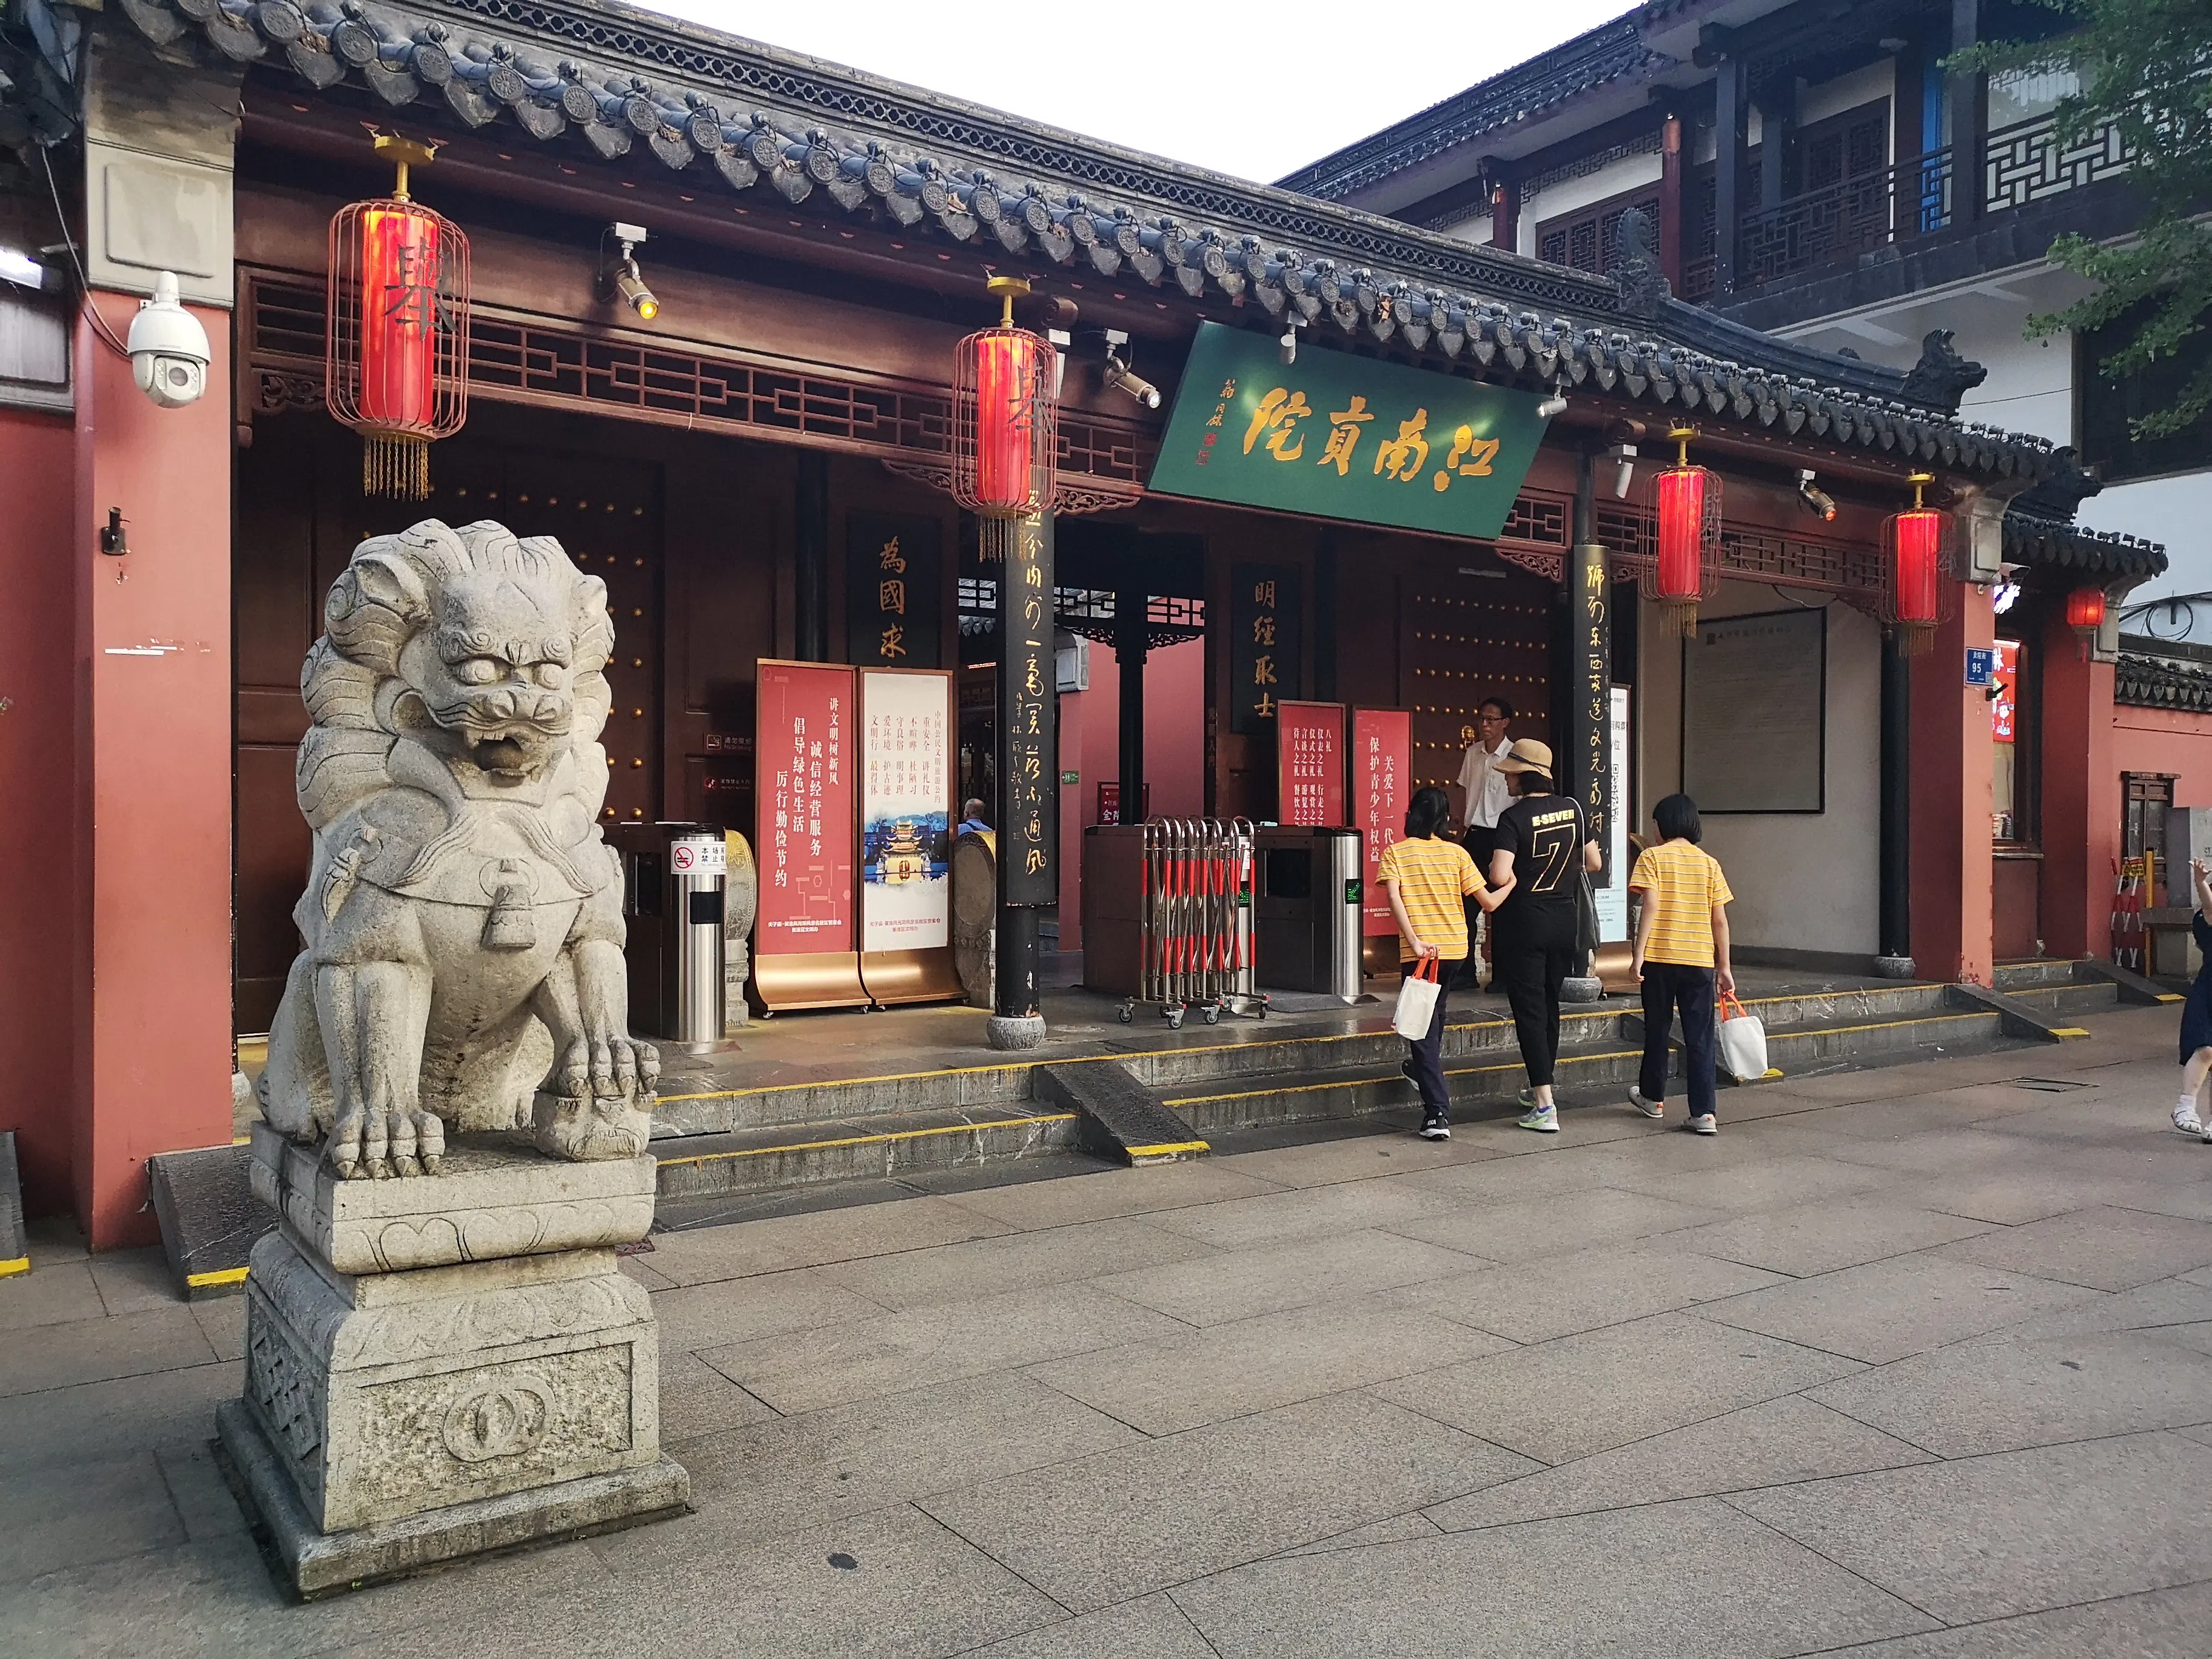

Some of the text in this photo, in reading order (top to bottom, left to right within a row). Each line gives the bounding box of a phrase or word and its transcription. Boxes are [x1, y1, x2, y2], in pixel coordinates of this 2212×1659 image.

[1972, 663, 1982, 673] 95
[793, 717, 805, 833] 倡导绿色生活
[828, 697, 839, 786] 讲文明树新风
[1326, 728, 1332, 752] 八礼
[775, 771, 788, 888] 厉行勤俭节约
[809, 740, 822, 856] 诚信经营服务
[1369, 736, 1380, 862] 保护青少年权益
[1383, 756, 1394, 845] 关爱下一代
[1531, 823, 1576, 892] 7
